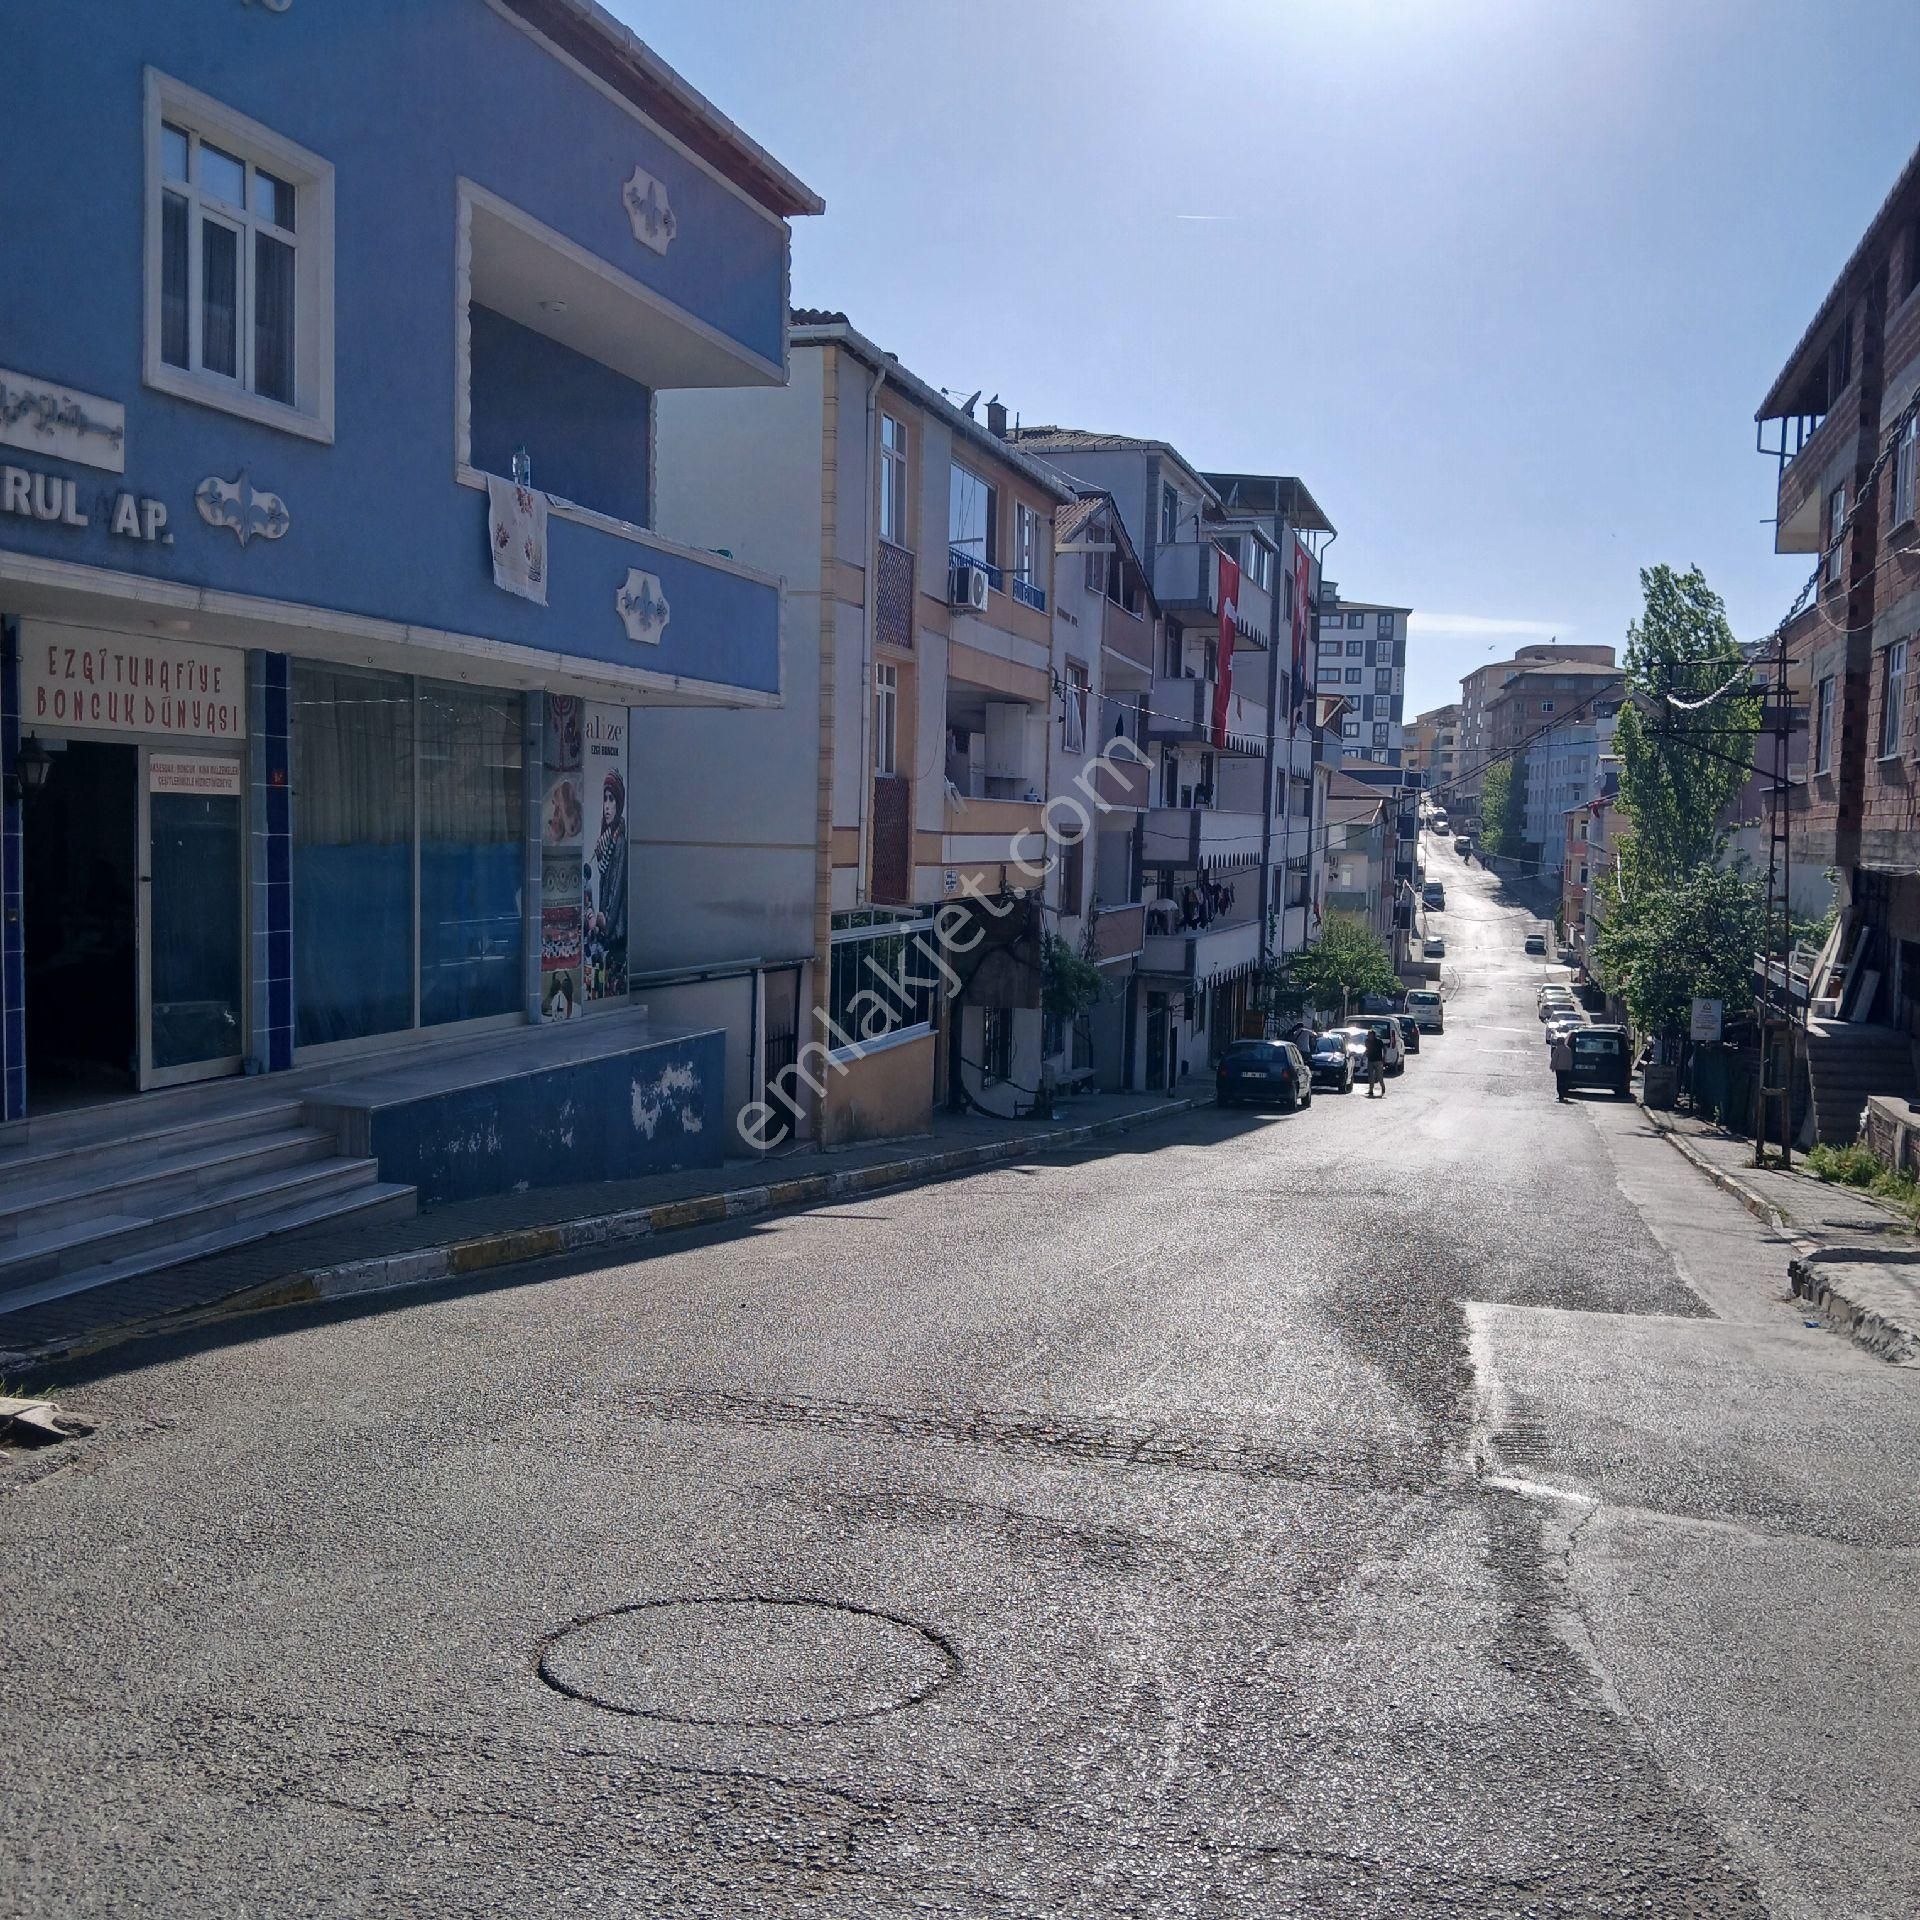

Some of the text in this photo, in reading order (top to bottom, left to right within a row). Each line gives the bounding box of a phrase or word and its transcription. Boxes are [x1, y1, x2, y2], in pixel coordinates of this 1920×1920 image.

[0, 465, 174, 544] RUL AP.
[48, 646, 221, 693] EZGİ TUHAFİYE
[37, 686, 237, 734] BONCUK DÜNYASI
[586, 715, 622, 741] alize
